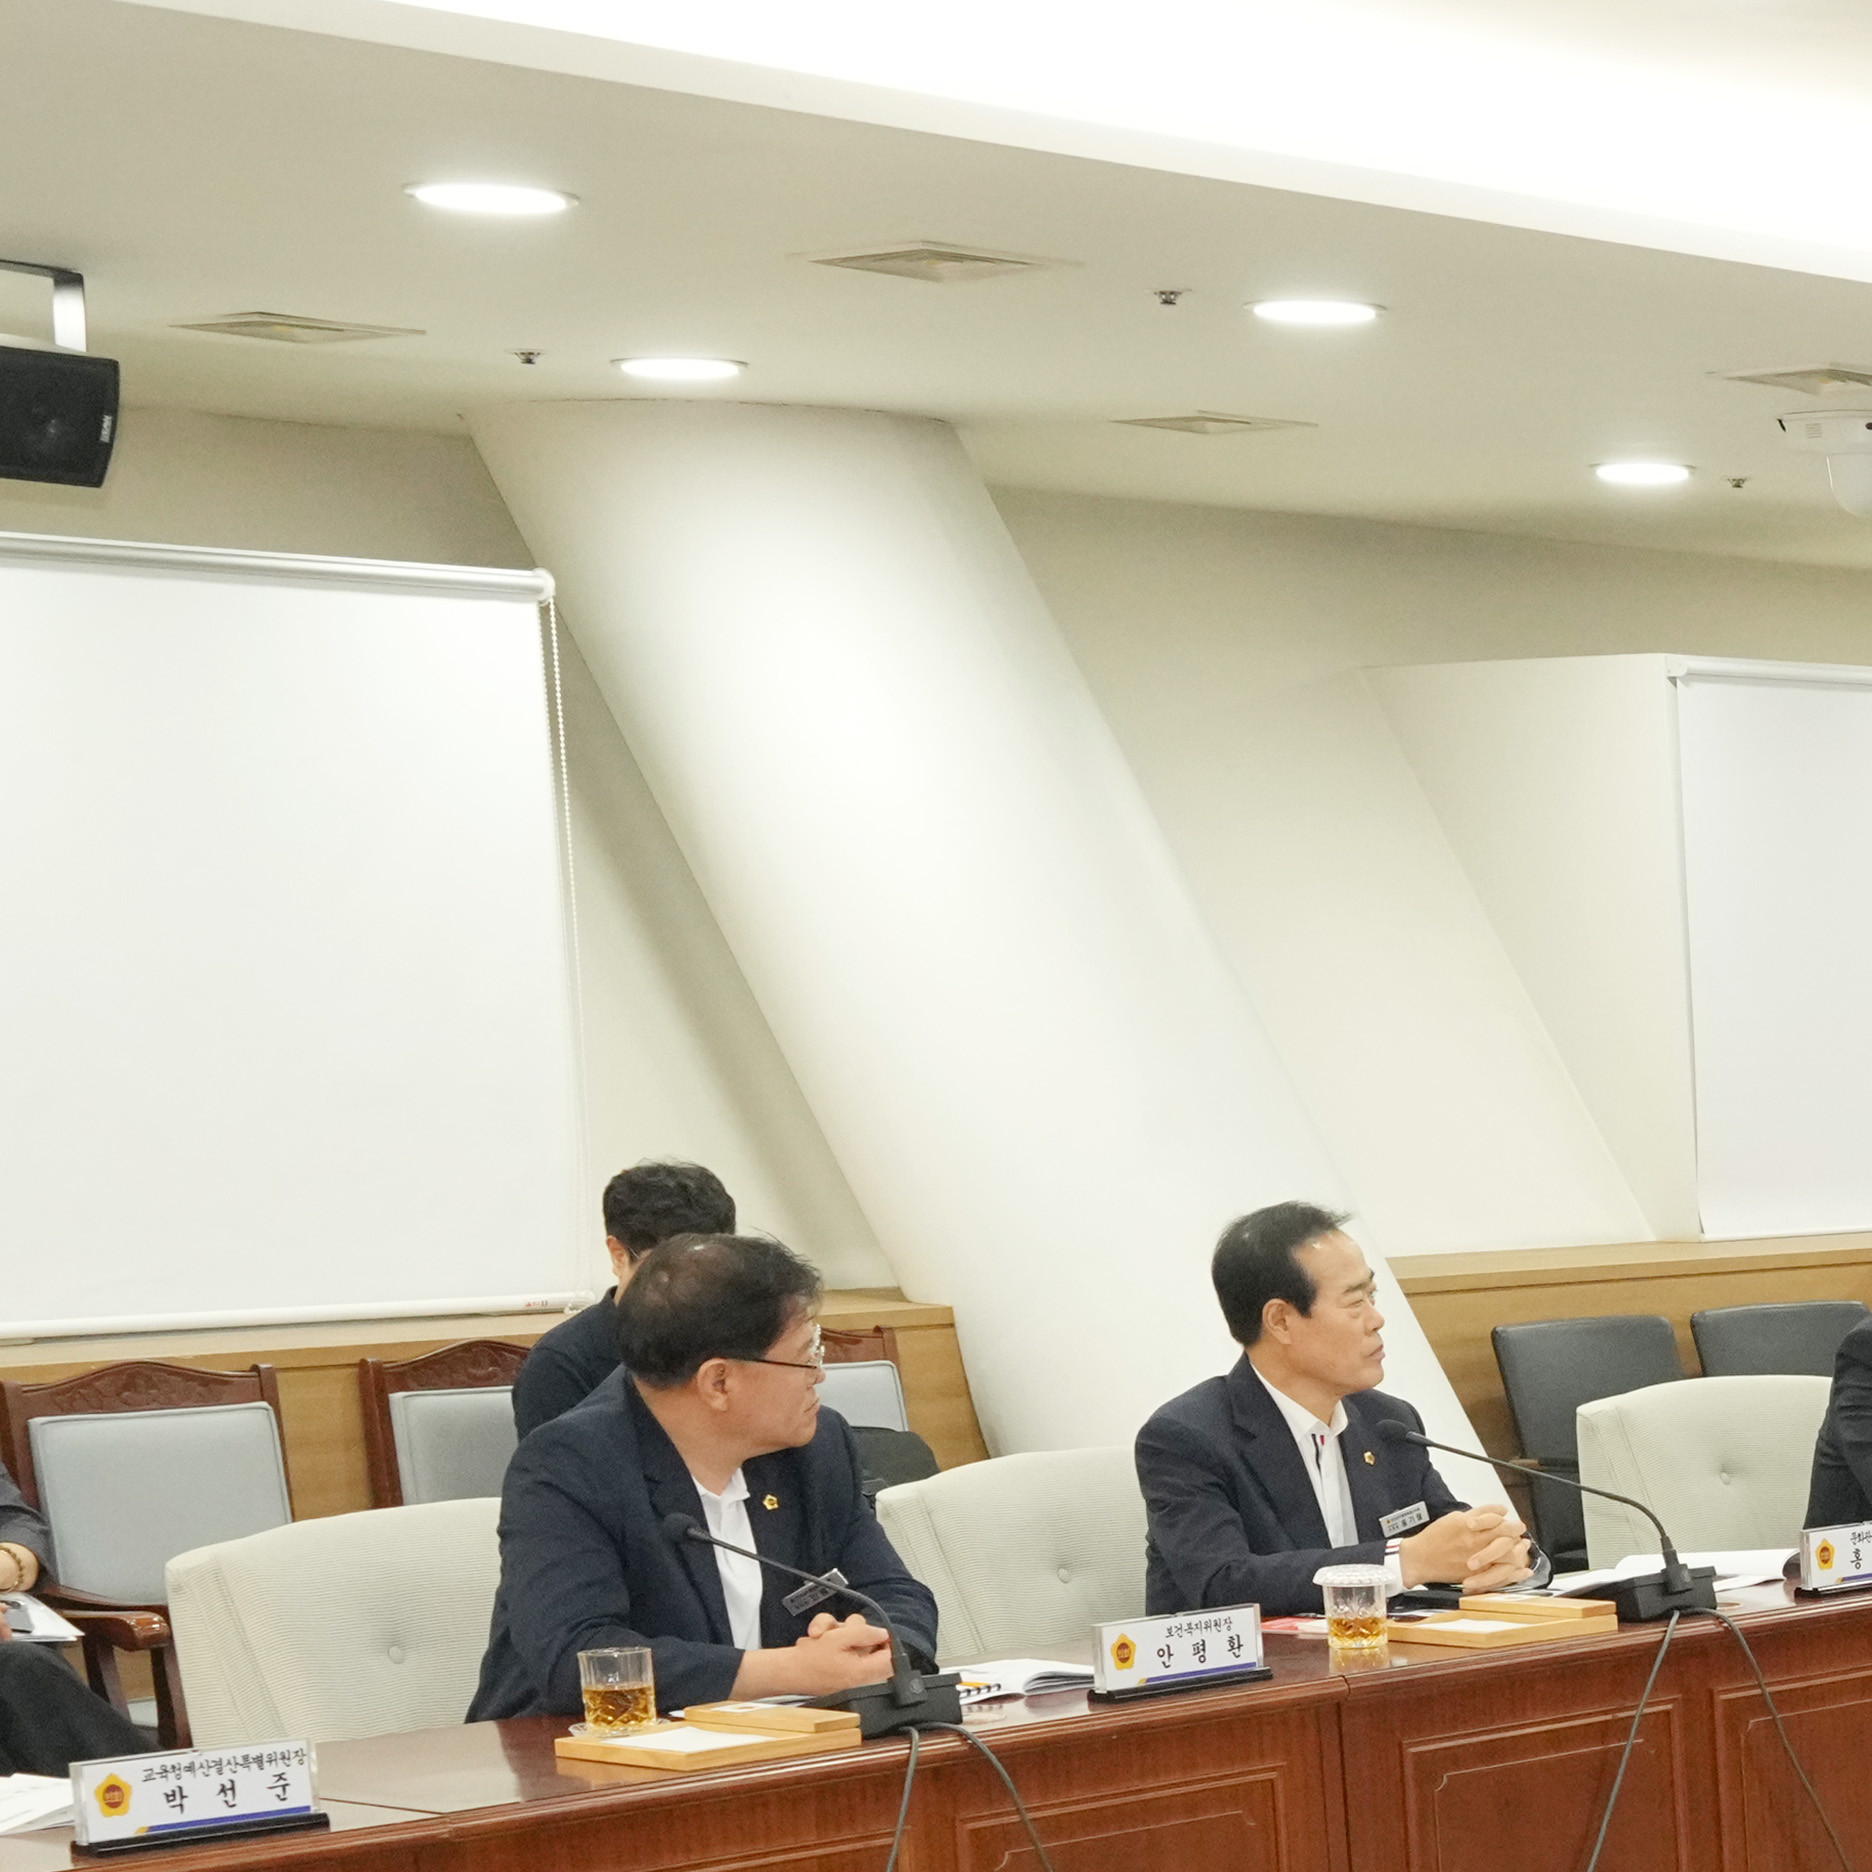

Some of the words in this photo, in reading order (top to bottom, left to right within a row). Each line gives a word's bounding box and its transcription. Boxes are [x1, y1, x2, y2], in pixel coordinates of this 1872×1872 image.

[1165, 1616, 1233, 1639] 보건복지위원장
[141, 1747, 307, 1783] 교육청예산결산특별위원장
[163, 1771, 292, 1814] 박선준
